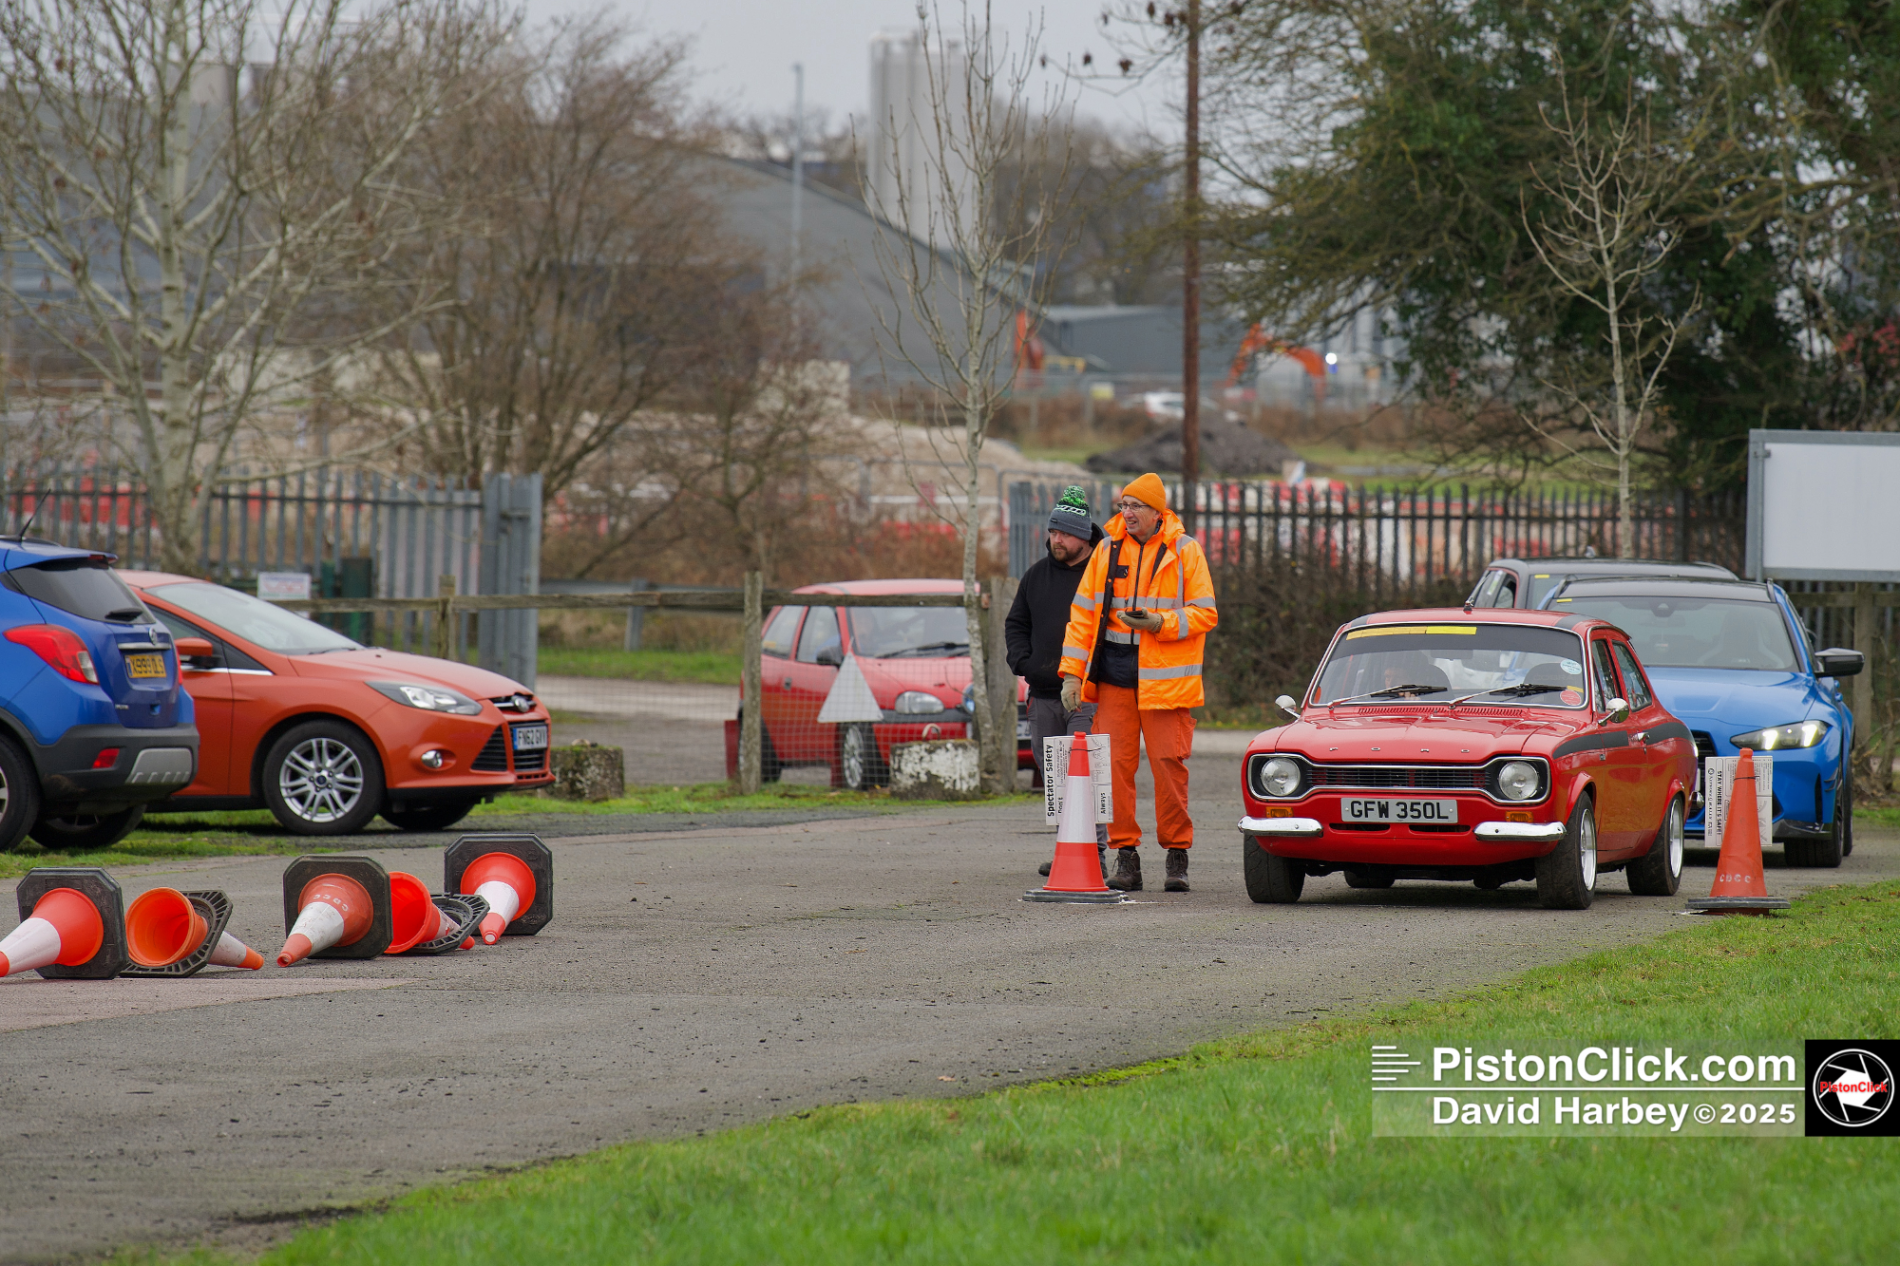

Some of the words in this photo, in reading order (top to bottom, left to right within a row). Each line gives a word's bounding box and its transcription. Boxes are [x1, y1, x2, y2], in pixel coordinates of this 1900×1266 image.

[1045, 744, 1054, 772] Safety
[1045, 775, 1056, 817] Spectator
[1350, 800, 1390, 819] GFW
[1396, 801, 1449, 820] 350L
